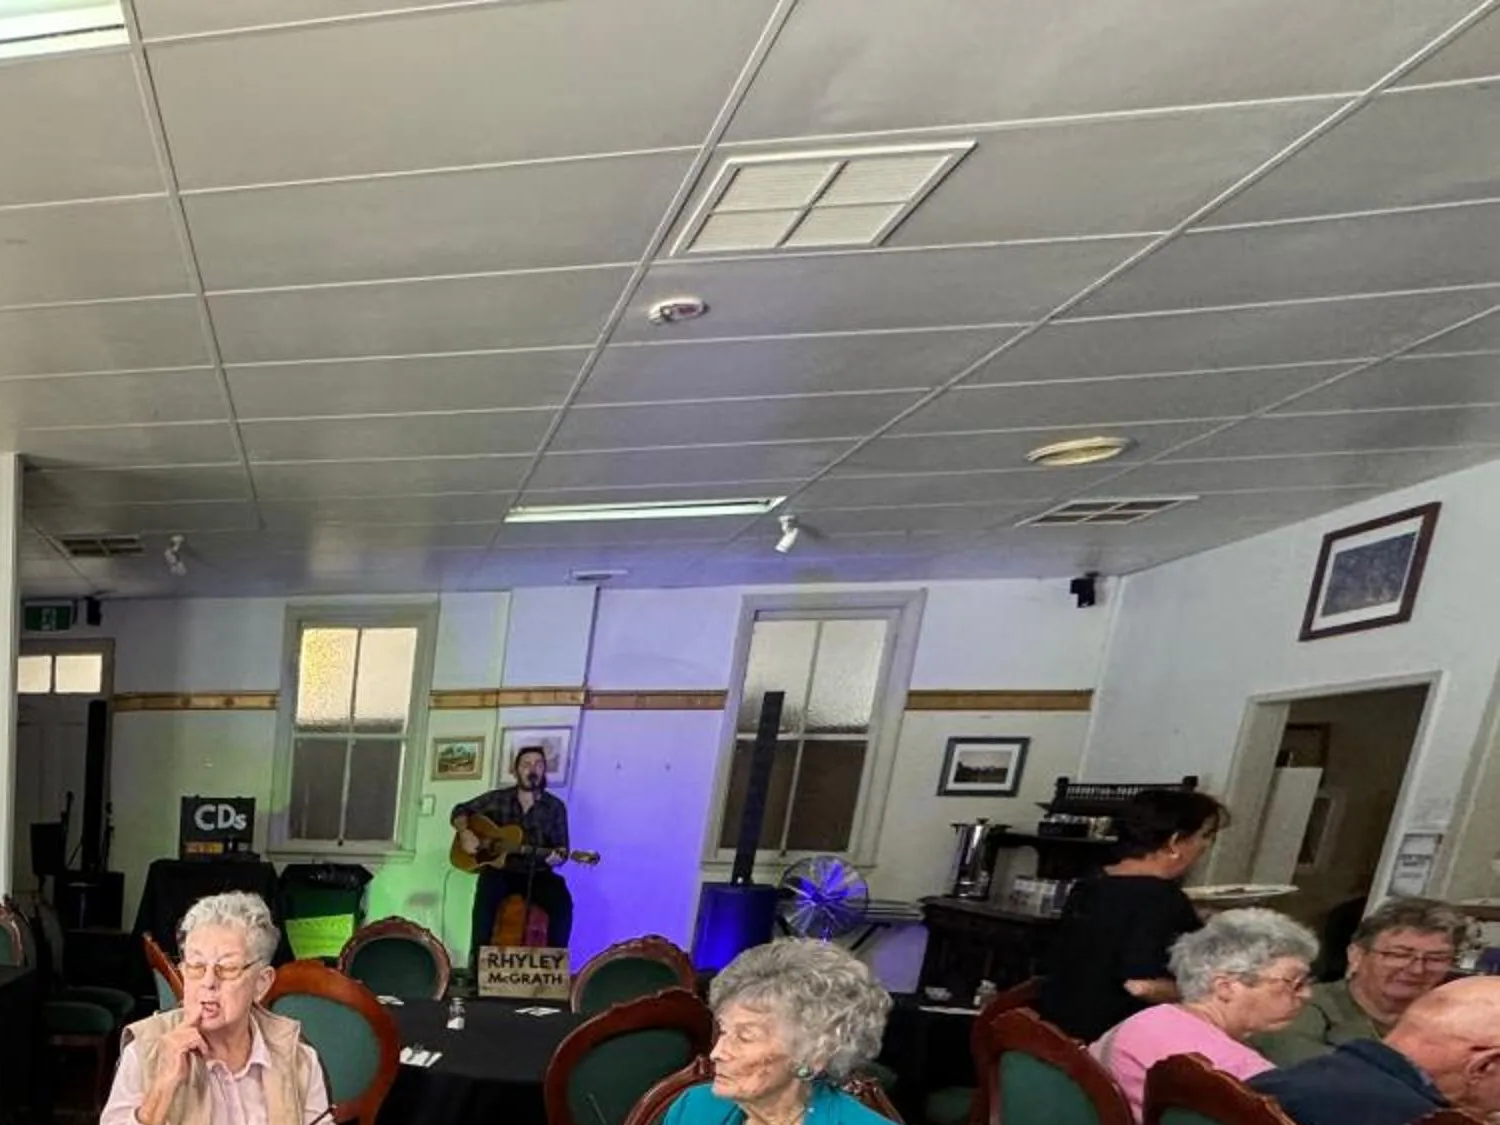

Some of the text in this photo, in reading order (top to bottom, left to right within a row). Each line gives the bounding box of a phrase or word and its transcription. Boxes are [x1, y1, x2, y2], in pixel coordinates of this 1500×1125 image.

[194, 803, 247, 831] CDs
[487, 953, 564, 969] RHYLEY
[488, 972, 562, 985] McGRATH
